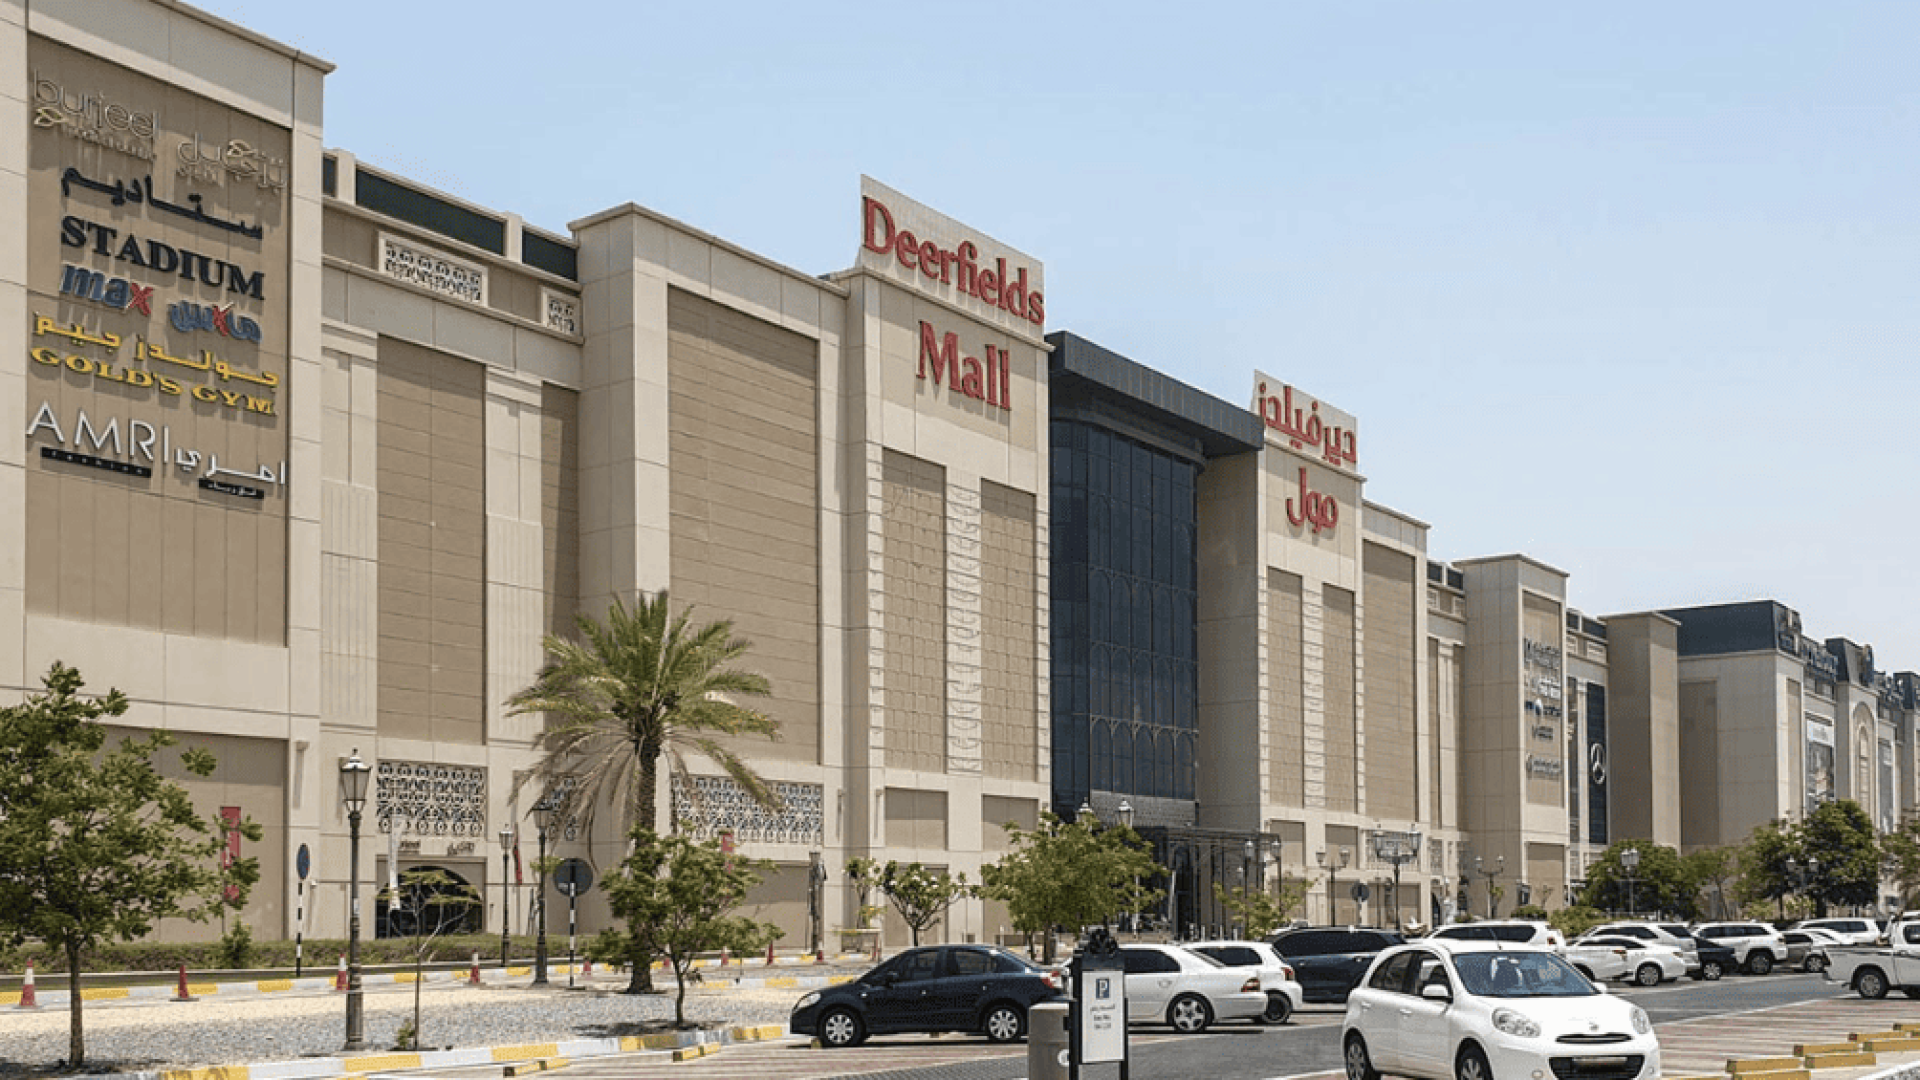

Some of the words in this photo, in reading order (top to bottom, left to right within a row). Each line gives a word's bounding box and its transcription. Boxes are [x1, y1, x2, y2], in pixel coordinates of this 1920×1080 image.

[34, 69, 158, 138] burjeel
[60, 264, 153, 316] max
[61, 215, 266, 300] STADIUM
[862, 195, 1045, 326] Deerfields
[33, 312, 122, 355] جيم
[916, 320, 1012, 411] Mall
[31, 347, 183, 395] GOLD'S
[191, 384, 277, 416] GYM
[26, 400, 170, 464] AMRI
[1286, 467, 1338, 534] مول
